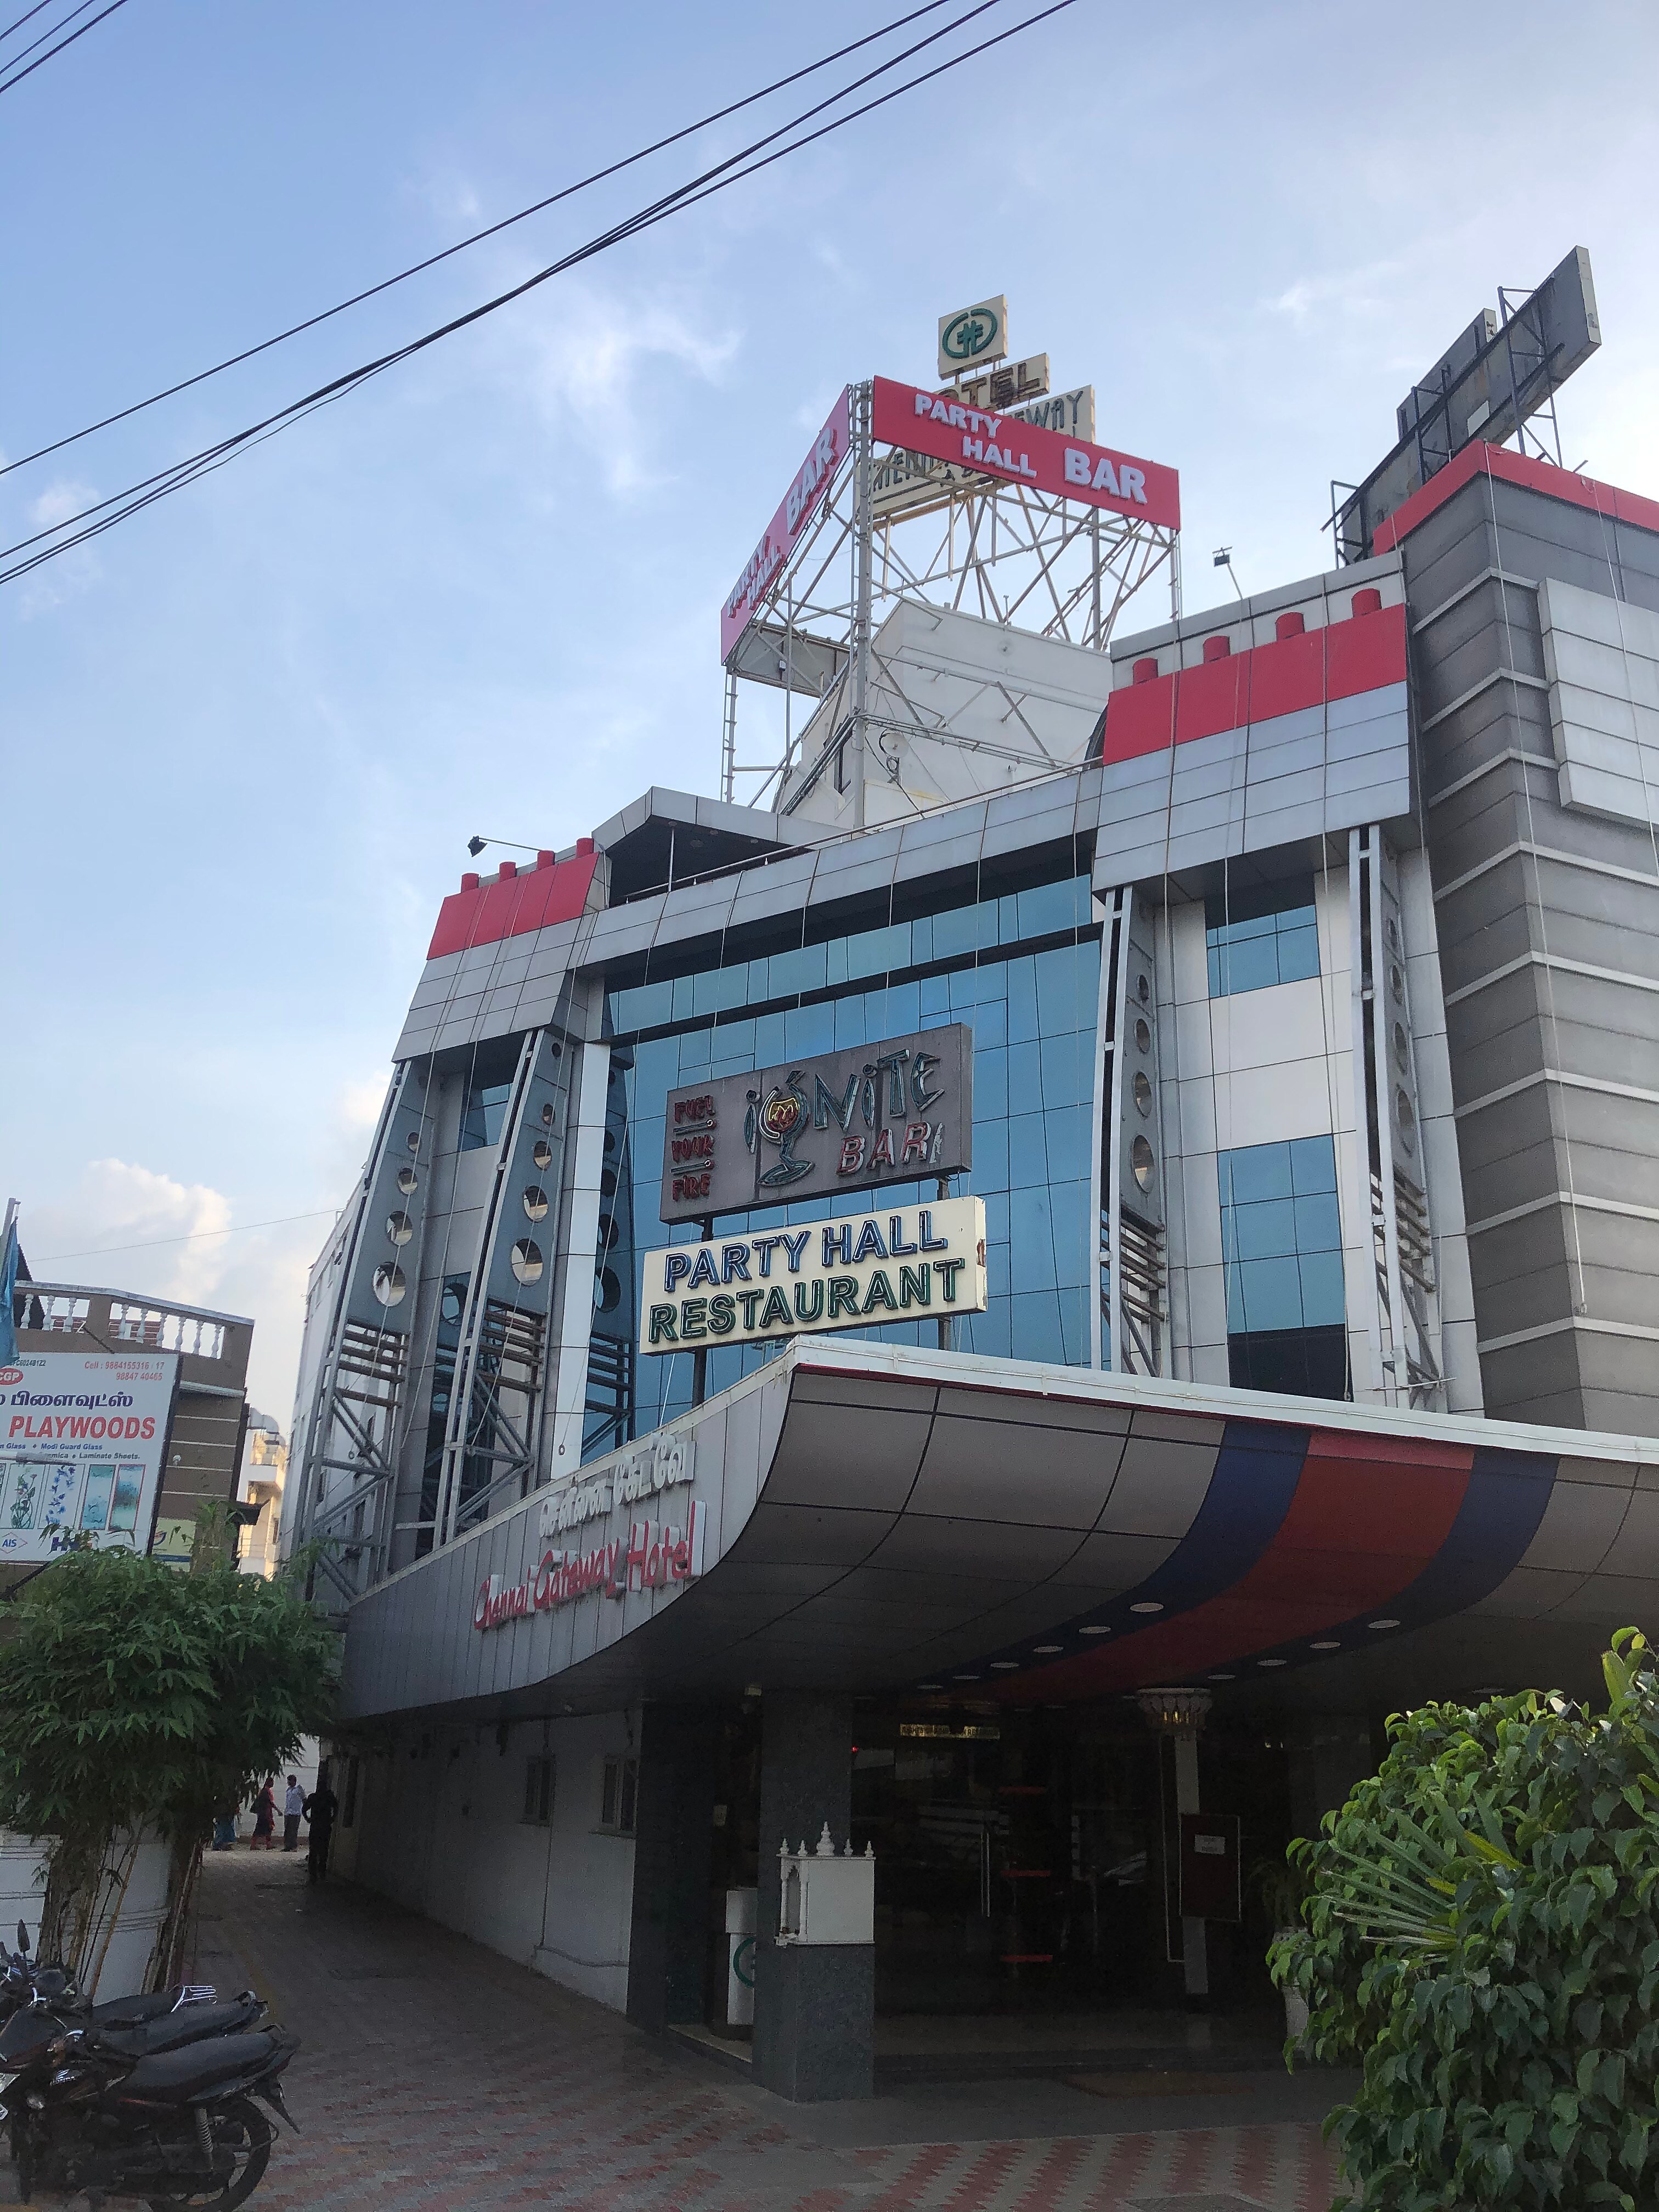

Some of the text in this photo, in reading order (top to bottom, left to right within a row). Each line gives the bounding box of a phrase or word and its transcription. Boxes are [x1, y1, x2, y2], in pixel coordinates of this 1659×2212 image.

[915, 393, 1002, 439] PARTY
[786, 427, 839, 535] BAR
[962, 436, 1037, 478] HALL
[1064, 448, 1148, 505] BAR
[727, 535, 770, 619] PARTY
[747, 545, 787, 611] HALL
[674, 1095, 714, 1123] FUEL
[672, 1135, 714, 1163] YOUR
[673, 1173, 710, 1201] FIRE
[664, 1210, 947, 1292] PARTY HALL
[648, 1257, 964, 1343] RESTAURANT
[9, 1415, 156, 1439] PLAYWOODS
[2, 1539, 17, 1548] AIS
[474, 1500, 702, 1630] Chennai Gateway Hotel
